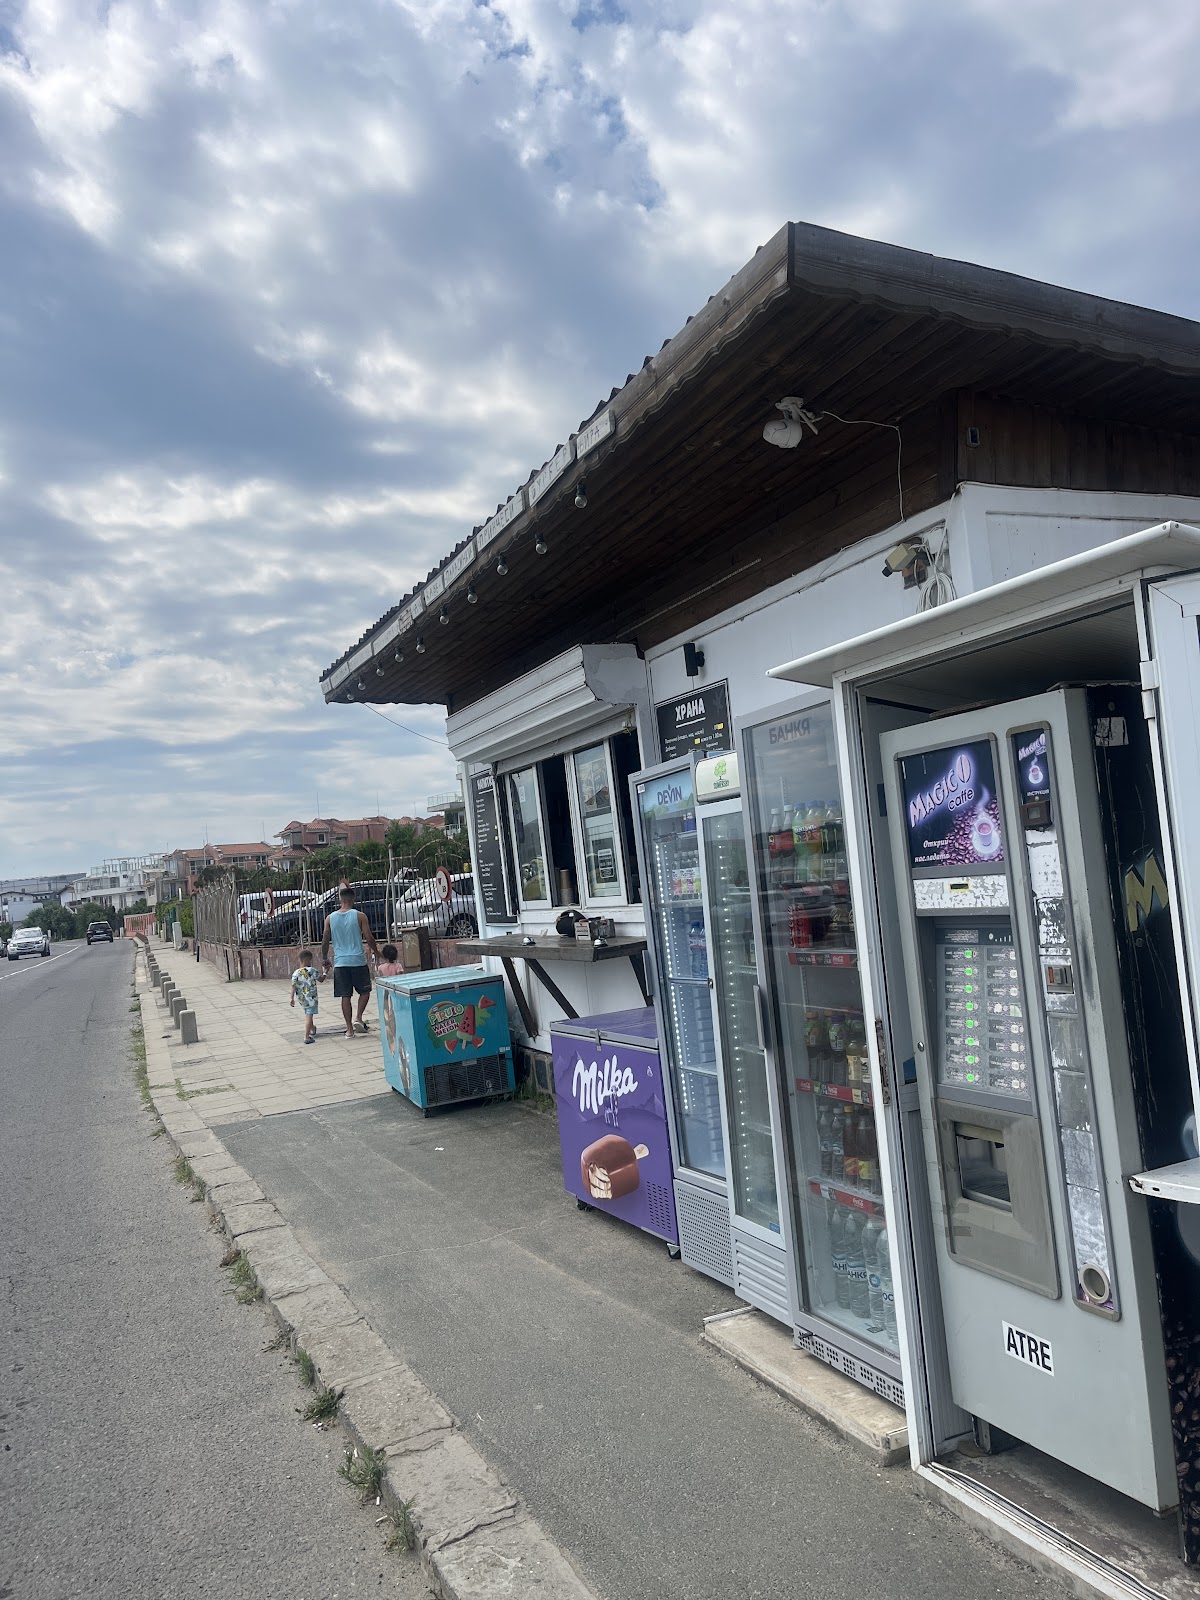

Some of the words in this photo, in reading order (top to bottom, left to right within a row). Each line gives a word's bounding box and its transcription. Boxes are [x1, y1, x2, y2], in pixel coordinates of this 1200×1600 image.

[675, 697, 706, 722] ХРАНА
[768, 717, 811, 745] БАНКЯ
[657, 784, 683, 806] DEVIN
[909, 767, 959, 828] MAGIC
[947, 787, 975, 812] caffe
[432, 1019, 456, 1032] WATER
[435, 1022, 460, 1037] MELON
[572, 1054, 639, 1115] Milka
[1006, 1326, 1053, 1373] ATRE
